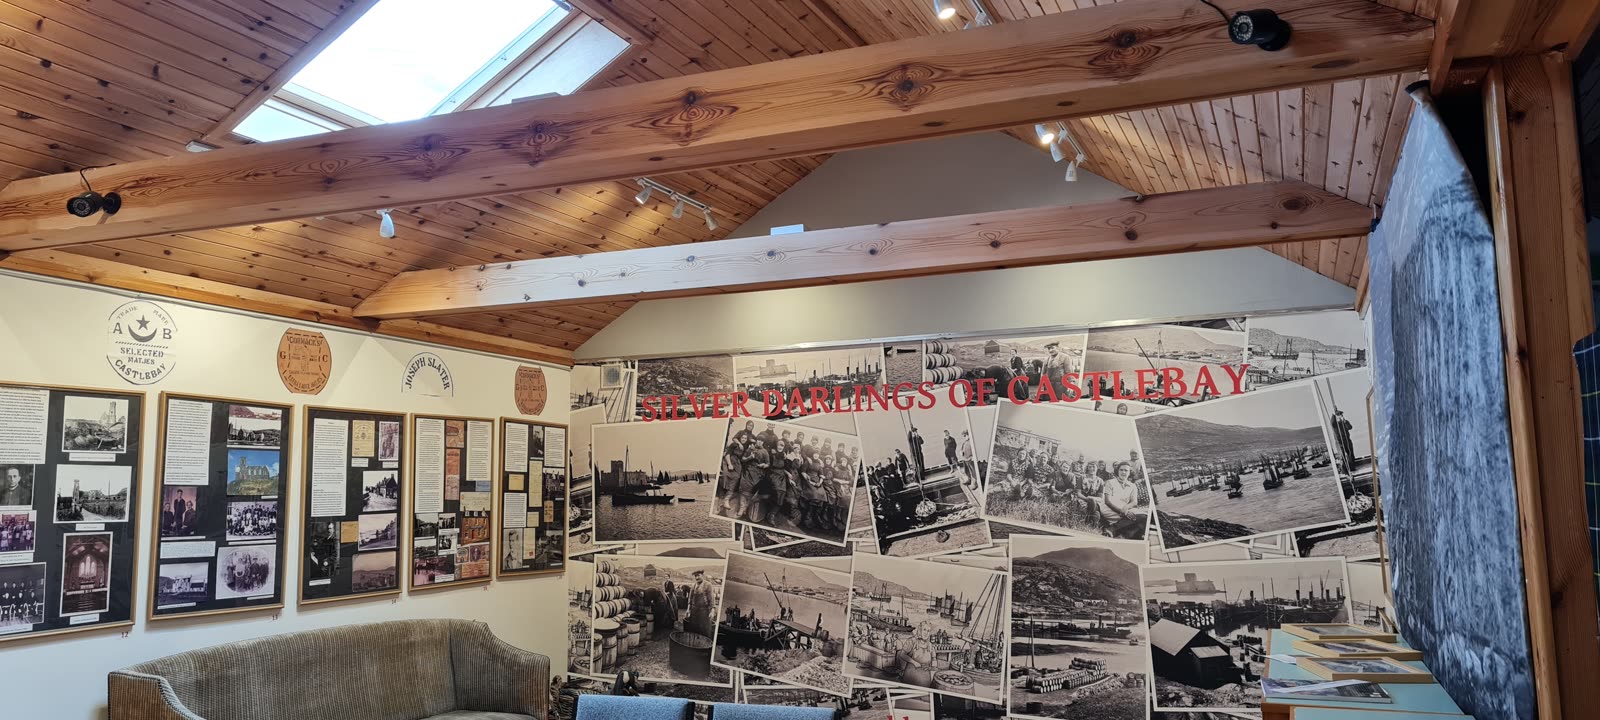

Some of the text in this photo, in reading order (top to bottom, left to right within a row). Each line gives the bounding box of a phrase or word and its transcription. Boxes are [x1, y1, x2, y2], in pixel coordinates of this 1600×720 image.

[116, 306, 137, 320] TRADE
[112, 322, 173, 340] A B
[120, 346, 164, 358] SELECTED
[127, 356, 156, 366] MATJES
[405, 356, 450, 390] JOSEPH SLATER
[641, 363, 1251, 423] SILVER DARLINGS OF CASTLEBAY
[121, 631, 129, 639] 12
